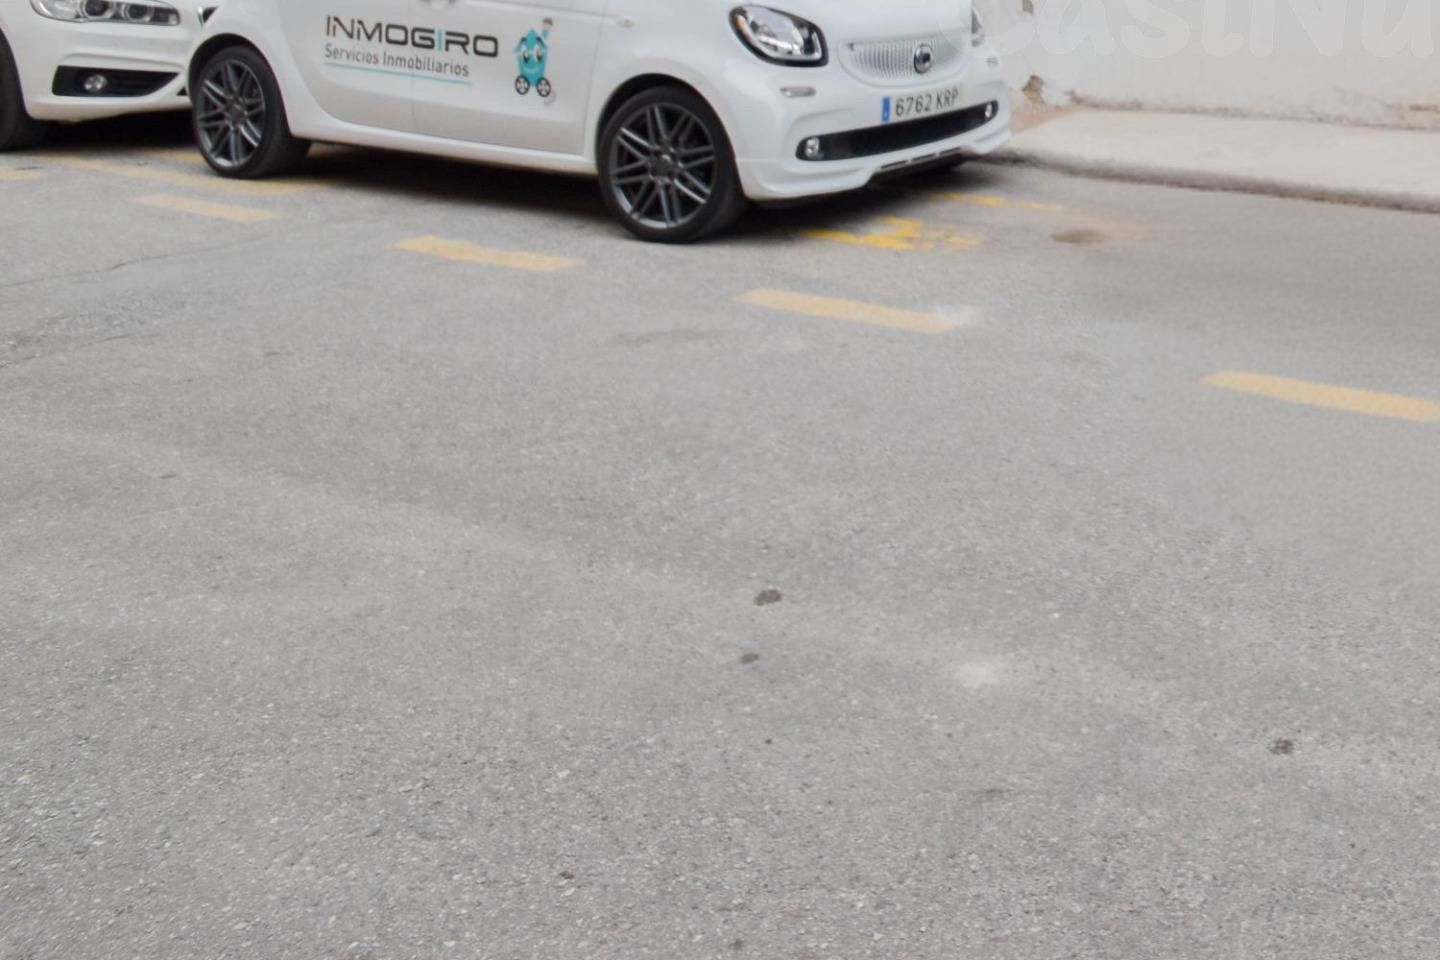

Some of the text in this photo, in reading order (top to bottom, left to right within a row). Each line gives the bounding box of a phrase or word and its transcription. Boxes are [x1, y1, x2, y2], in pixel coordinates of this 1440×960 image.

[325, 15, 499, 58] INMOGIRO
[325, 43, 470, 78] Servicios Inmobiliarios
[896, 87, 959, 117] 6762 KRP
